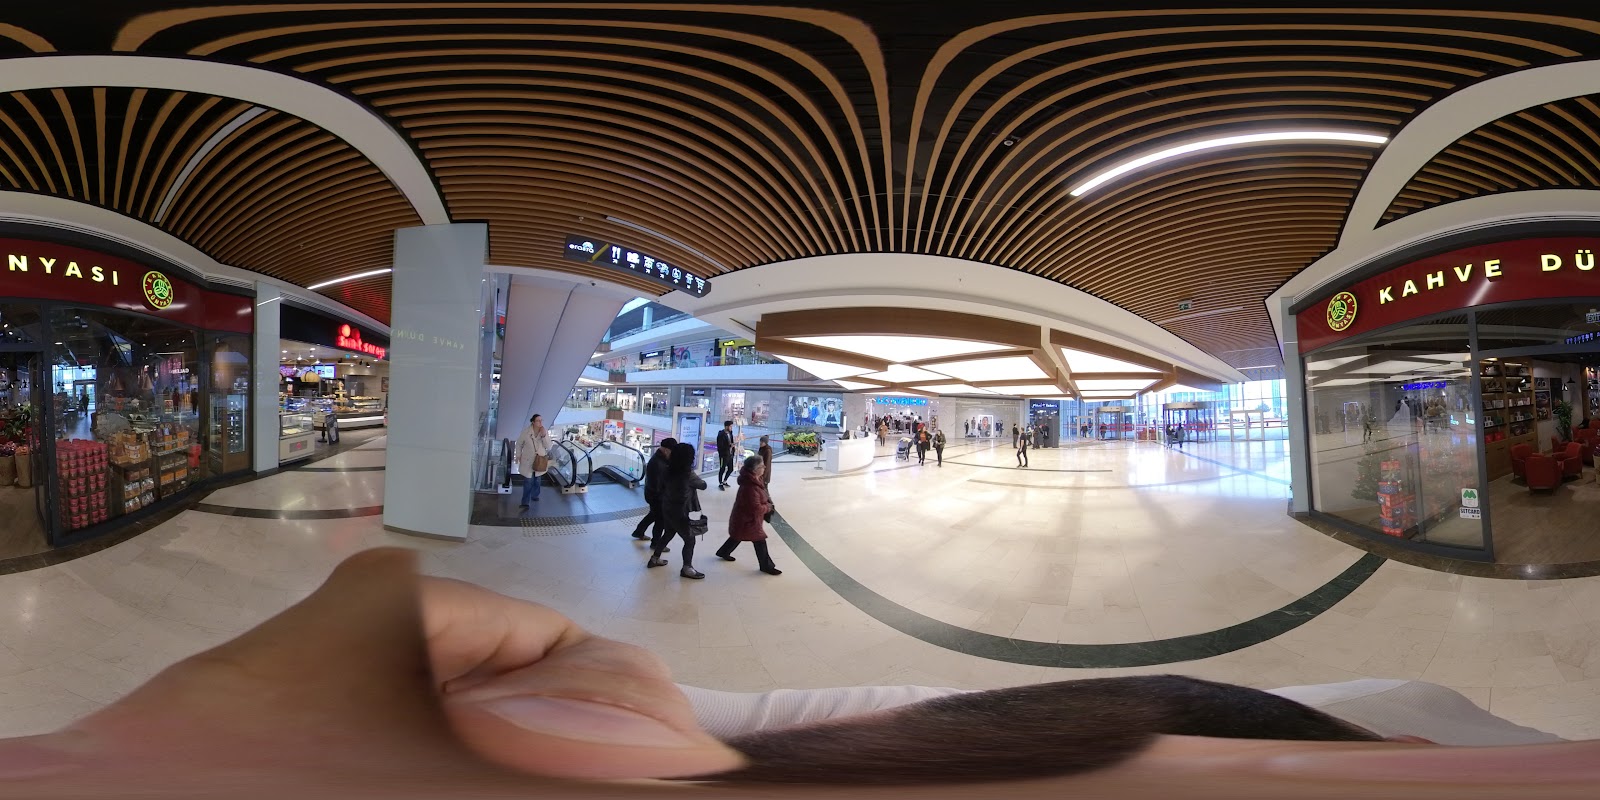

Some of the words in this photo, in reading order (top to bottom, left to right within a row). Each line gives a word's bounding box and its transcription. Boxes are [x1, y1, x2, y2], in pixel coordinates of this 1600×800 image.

[8, 254, 119, 286] NYASI
[1379, 259, 1502, 304] KAHVE
[1541, 249, 1595, 272] DÜ
